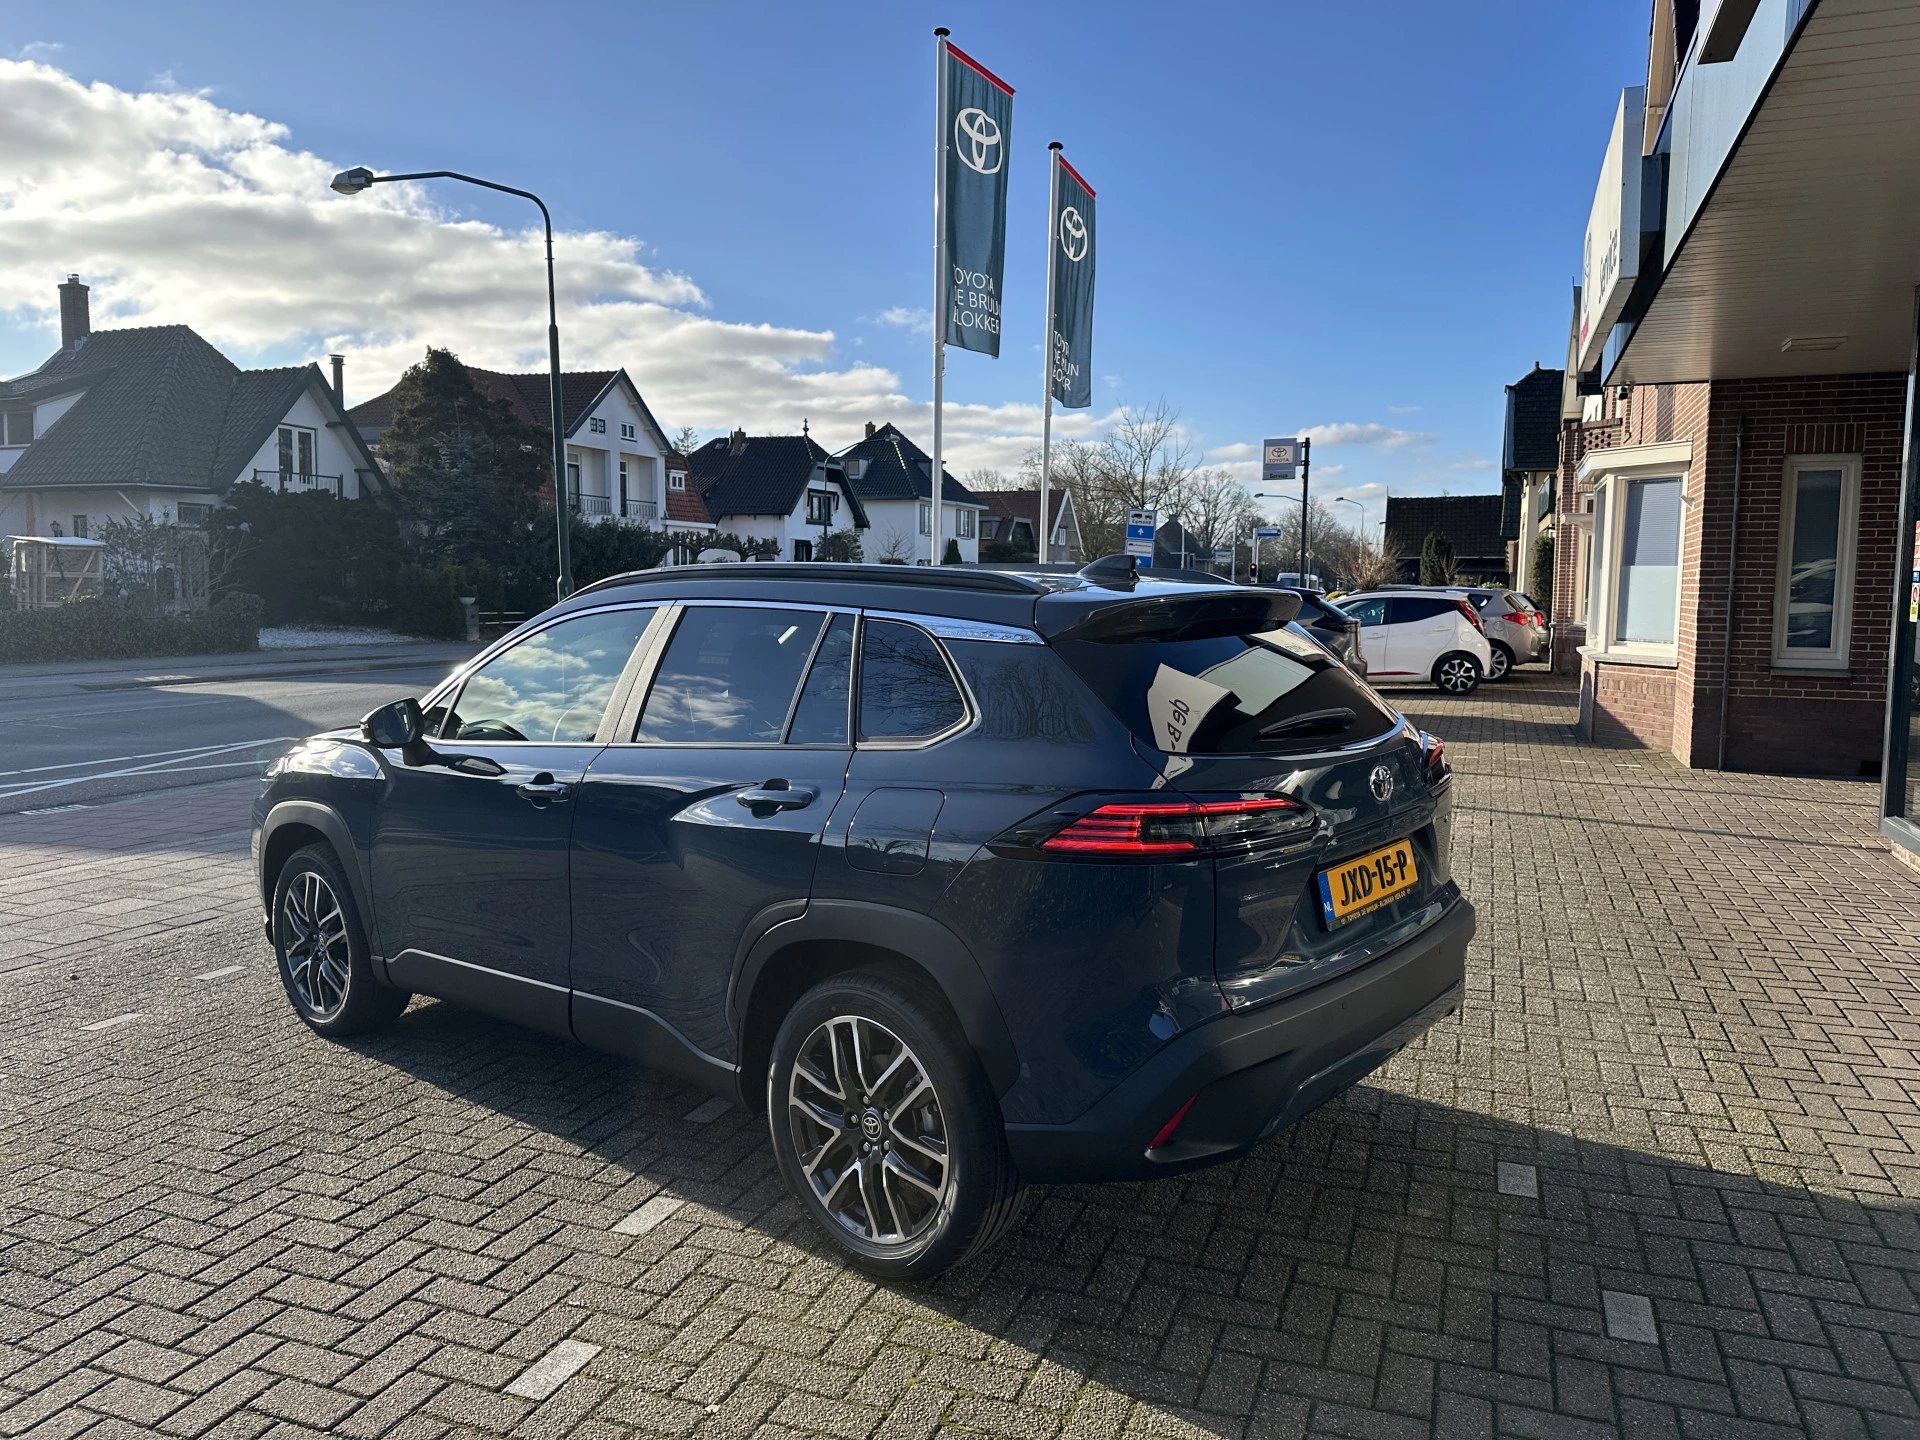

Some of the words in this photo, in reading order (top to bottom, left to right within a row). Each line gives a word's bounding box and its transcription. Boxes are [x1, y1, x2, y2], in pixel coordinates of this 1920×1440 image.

[968, 291, 1001, 317] BRUIJ
[1341, 850, 1407, 906] JXD-15-P
[1323, 901, 1333, 912] NL
